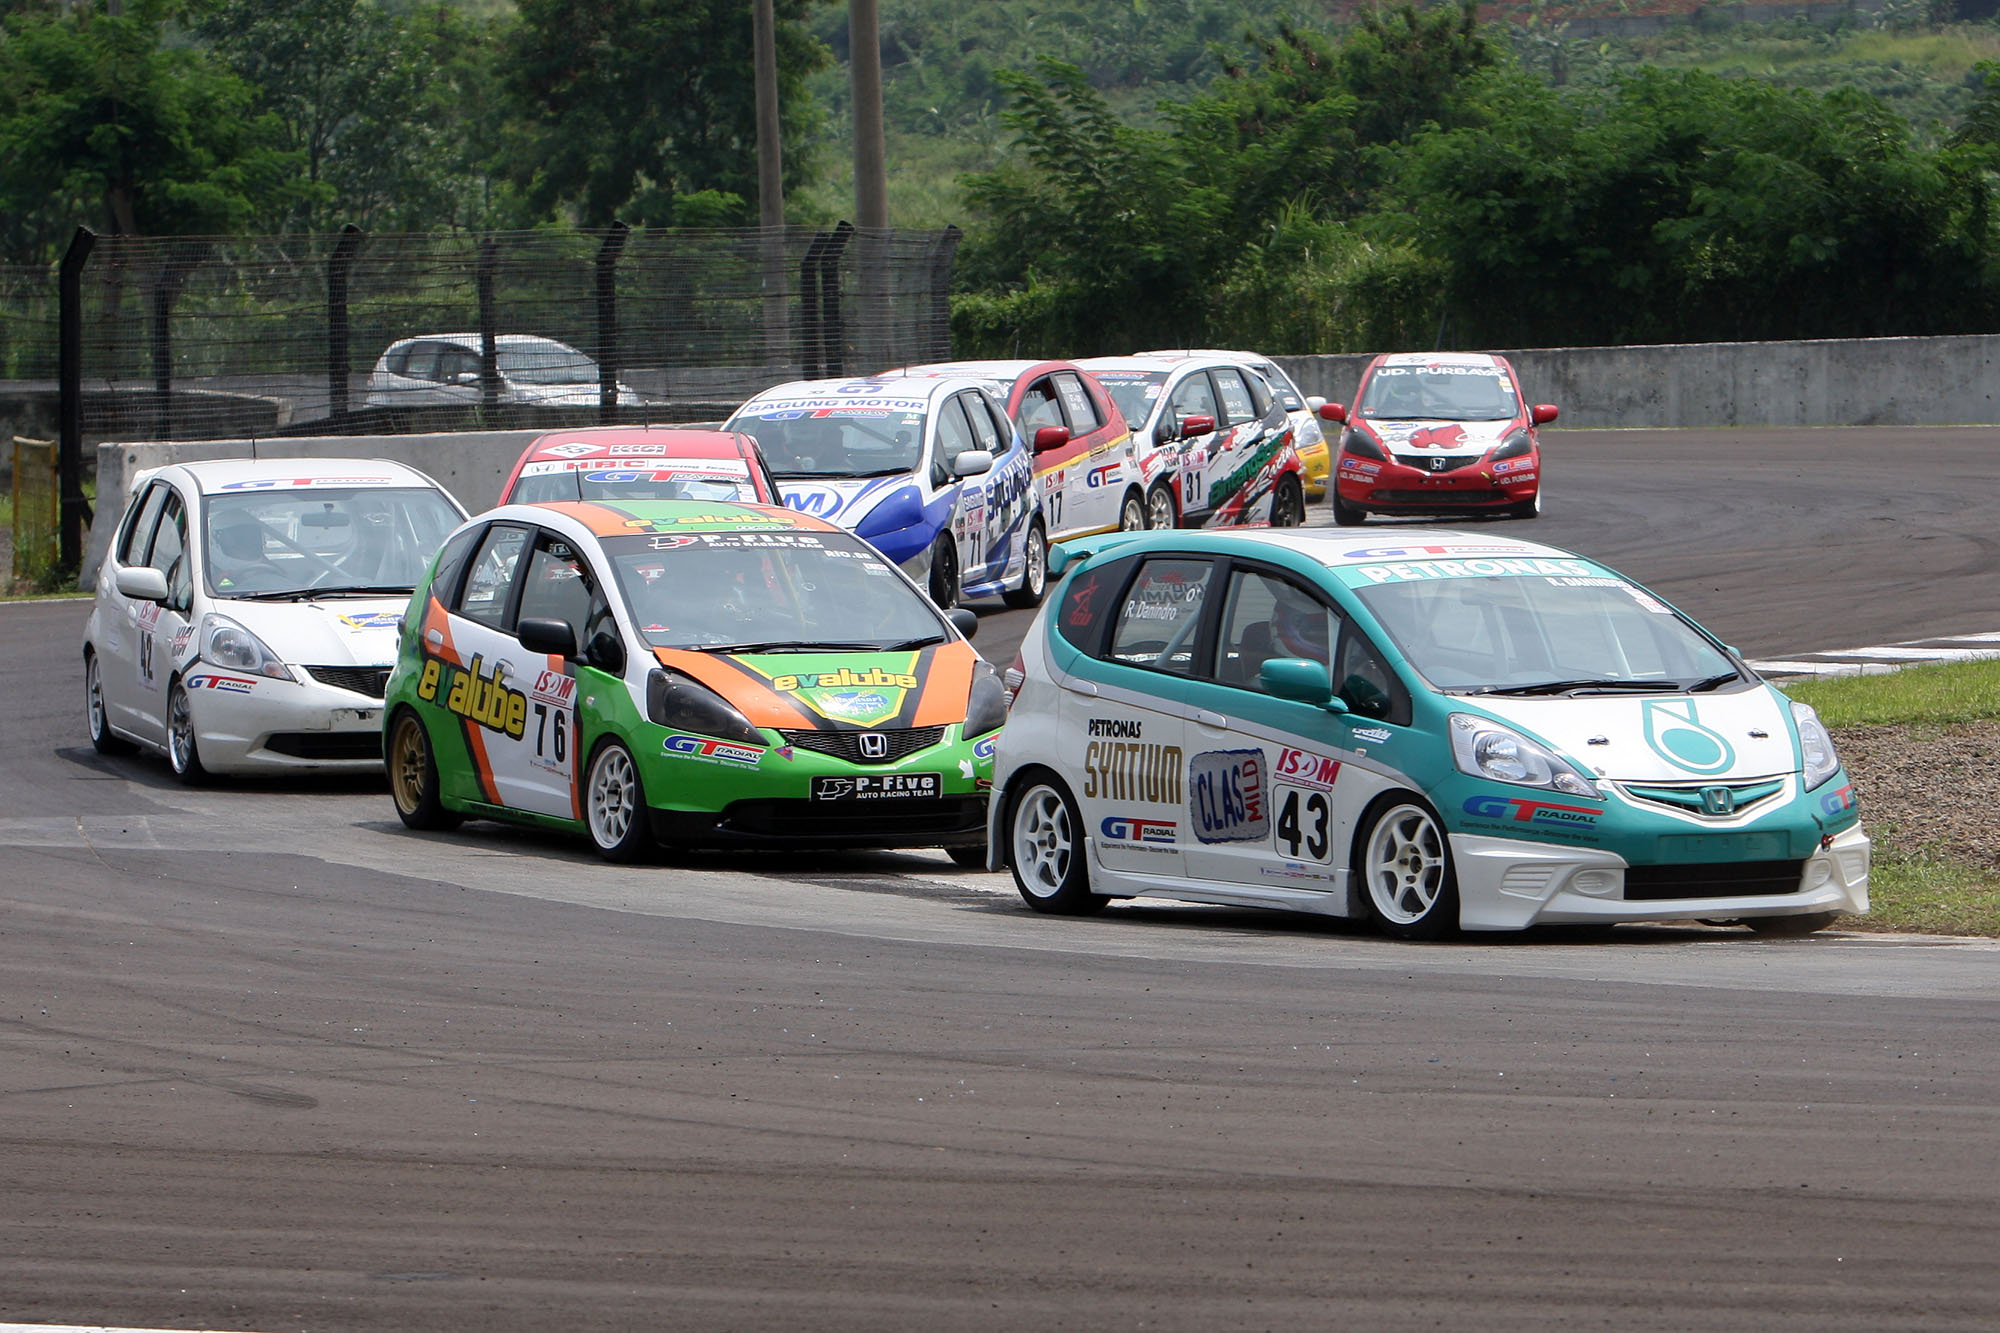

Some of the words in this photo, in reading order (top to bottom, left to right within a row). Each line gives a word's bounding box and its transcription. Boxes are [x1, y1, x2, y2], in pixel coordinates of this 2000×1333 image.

[1377, 368, 1411, 377] UD.
[747, 401, 840, 413] SAGUNG
[844, 400, 925, 410] MOTOR
[1186, 470, 1201, 503] 31
[1048, 490, 1063, 527] 17
[970, 529, 982, 567] 71
[1357, 560, 1592, 583] PETRONAS
[1135, 601, 1178, 621] Danindro
[140, 630, 154, 681] 42
[218, 681, 254, 690] RADIAL
[772, 667, 919, 693] evalube
[417, 652, 527, 742] evalube
[534, 703, 566, 763] 76
[1088, 718, 1142, 739] PETRONAS
[716, 747, 761, 760] RADIAL
[855, 776, 935, 791] P-Five
[1083, 740, 1184, 806] SYNTIUM
[880, 790, 911, 798] RACING
[912, 789, 935, 797] TEAM
[1197, 764, 1245, 832] CLAS
[1241, 759, 1264, 823] MILD
[1100, 816, 1143, 841] GT
[1142, 828, 1177, 837] RADIAL
[1277, 790, 1330, 861] 43
[1536, 809, 1598, 824] RADIAL
